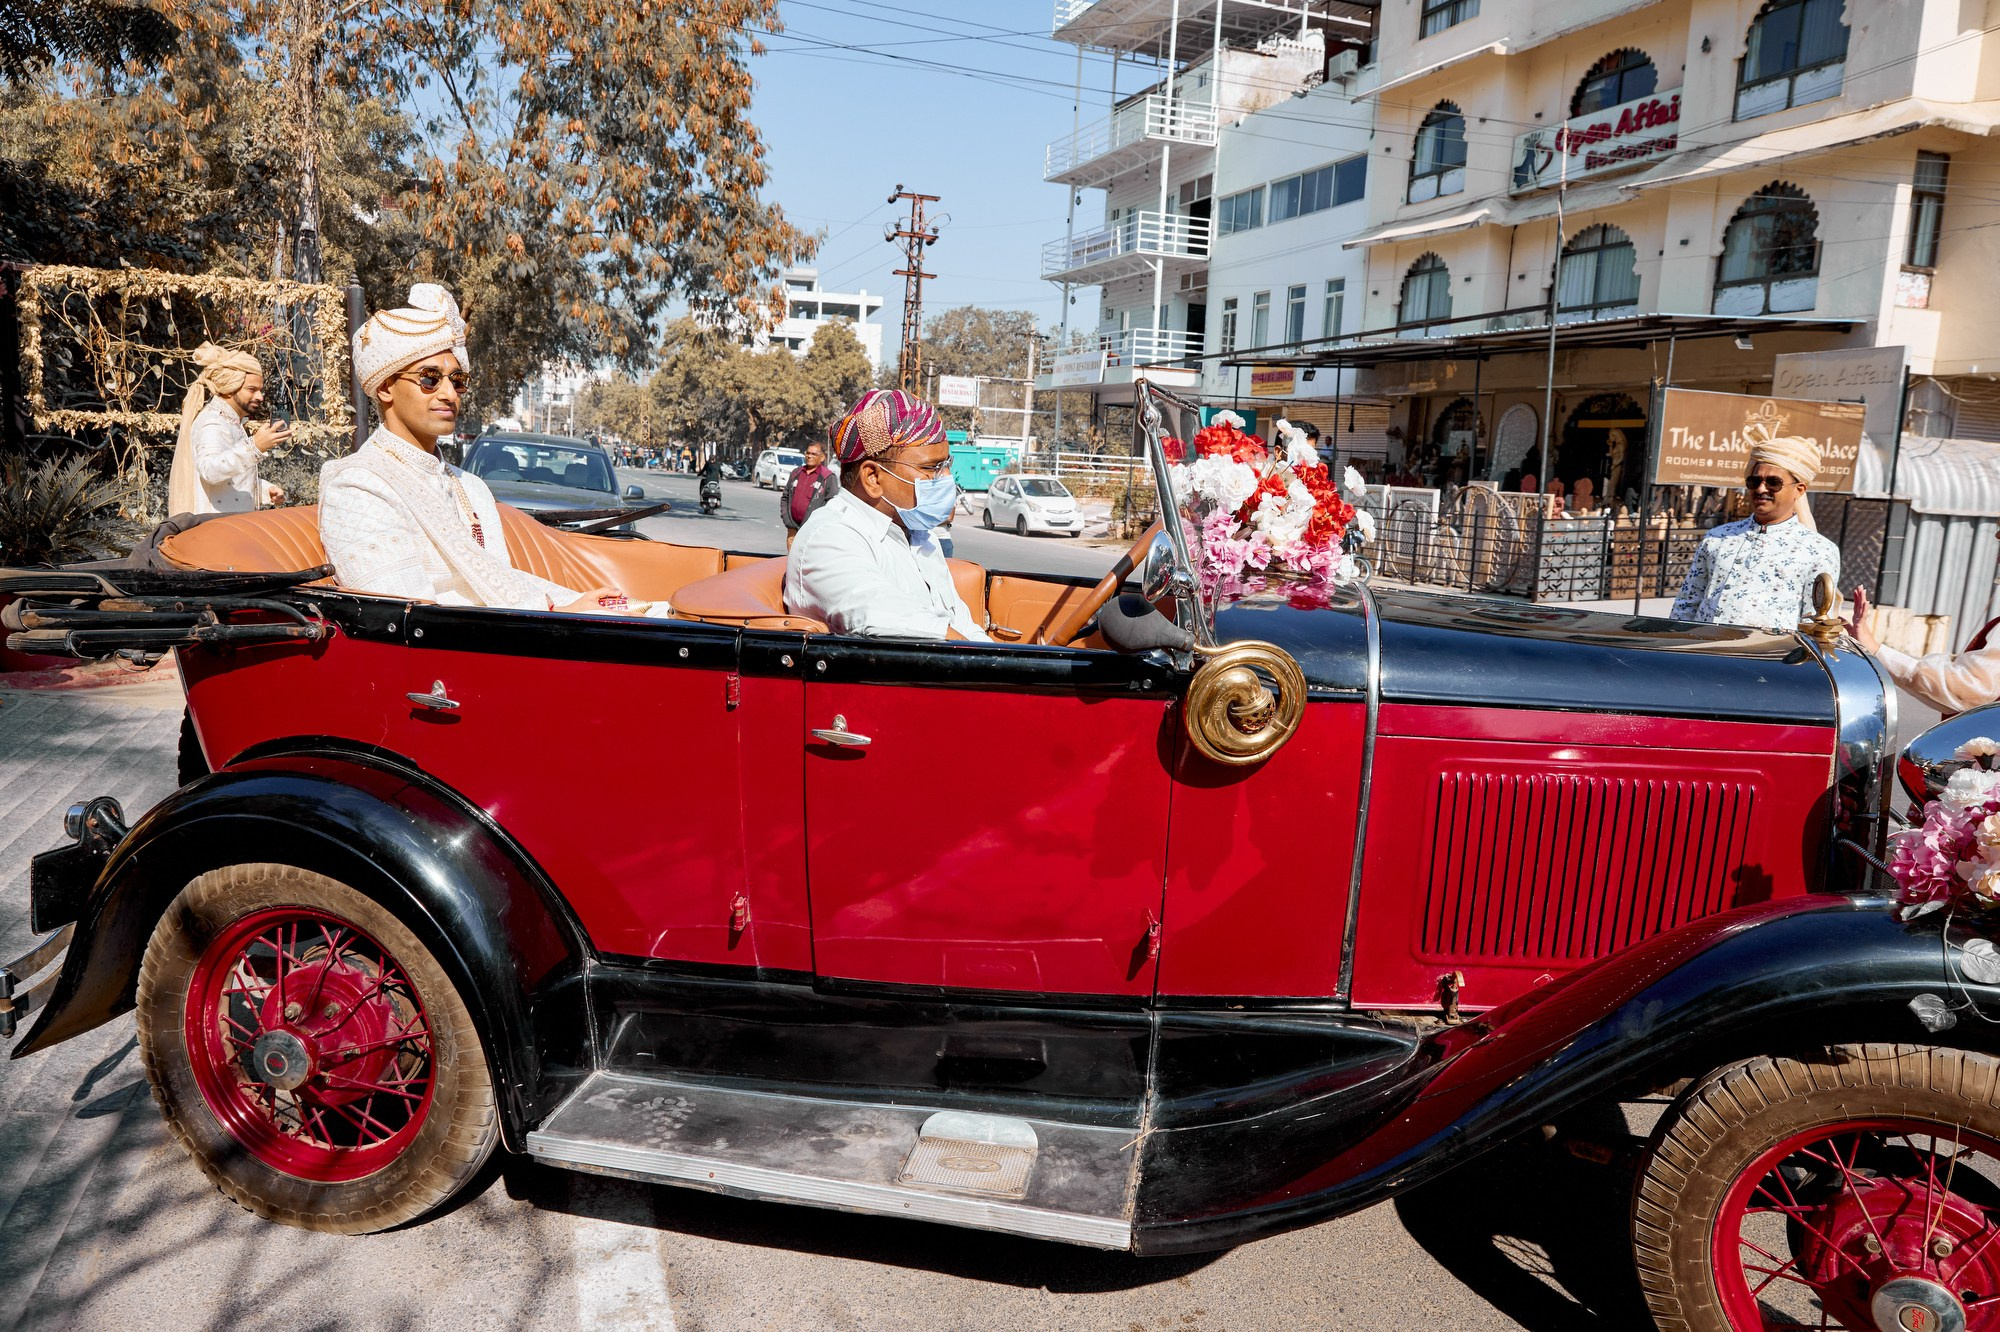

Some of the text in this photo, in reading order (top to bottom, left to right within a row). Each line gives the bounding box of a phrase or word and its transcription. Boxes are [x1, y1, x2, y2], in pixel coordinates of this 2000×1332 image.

[1555, 94, 1681, 157] Open Affai
[1585, 134, 1679, 170] Restauran
[1780, 364, 1899, 394] Open Affair
[1668, 426, 1705, 451] The
[1708, 430, 1750, 454] Lake
[1665, 456, 1706, 467] ROOMS
[1912, 1308, 1925, 1329] Ford
